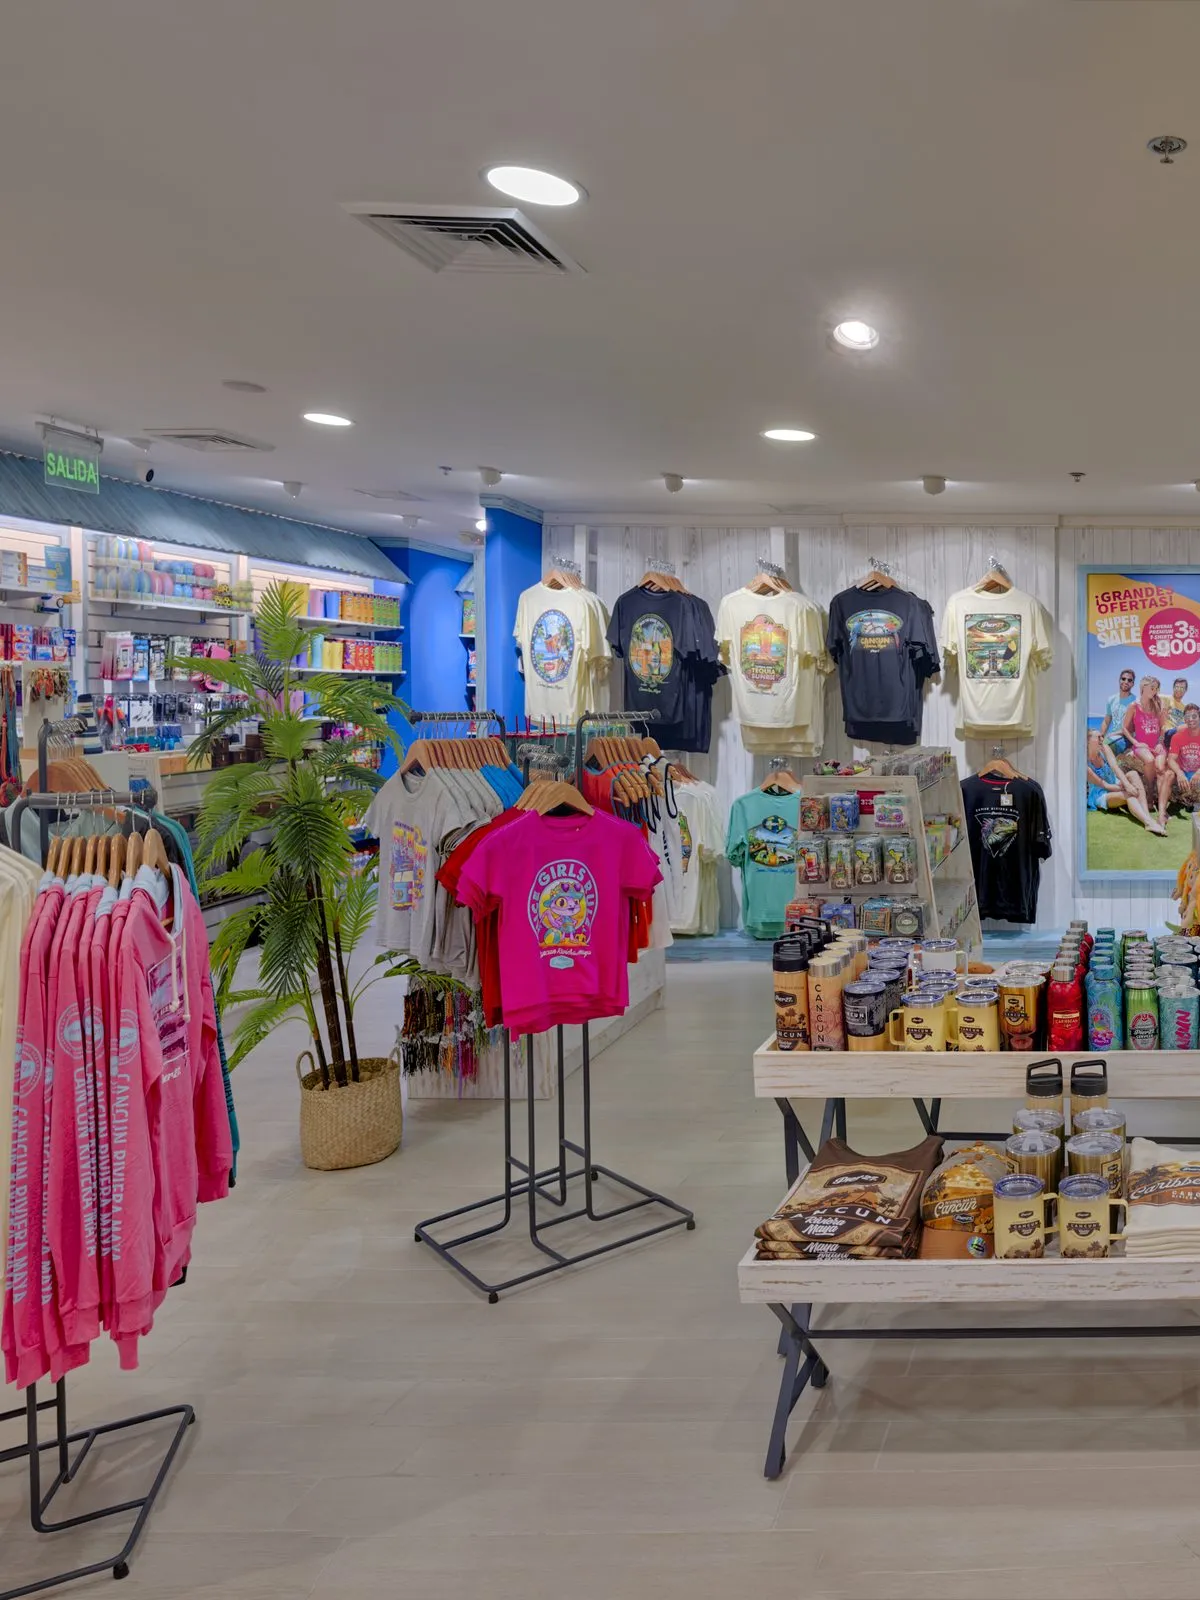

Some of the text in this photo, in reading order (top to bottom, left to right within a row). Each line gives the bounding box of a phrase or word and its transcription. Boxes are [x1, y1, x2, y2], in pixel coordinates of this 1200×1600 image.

[47, 453, 97, 484] SALIDA
[1095, 585, 1175, 606] ¡GRANDES
[1097, 595, 1174, 615] OFERTAS!
[1095, 614, 1140, 632] SUPER
[1096, 627, 1142, 649] SALE
[537, 863, 587, 887] GIRLS
[814, 984, 825, 1043] CANCUN
[74, 1066, 89, 1139] CANCUN
[114, 1073, 130, 1145] CANCUN
[770, 1206, 892, 1225] CANCUN
[934, 1199, 978, 1218] Cancun
[802, 1224, 839, 1236] Maya
[804, 1215, 847, 1226] Riviera
[111, 1219, 123, 1262] MAYA
[803, 1241, 840, 1253] Maya
[13, 1255, 28, 1306] MAYA
